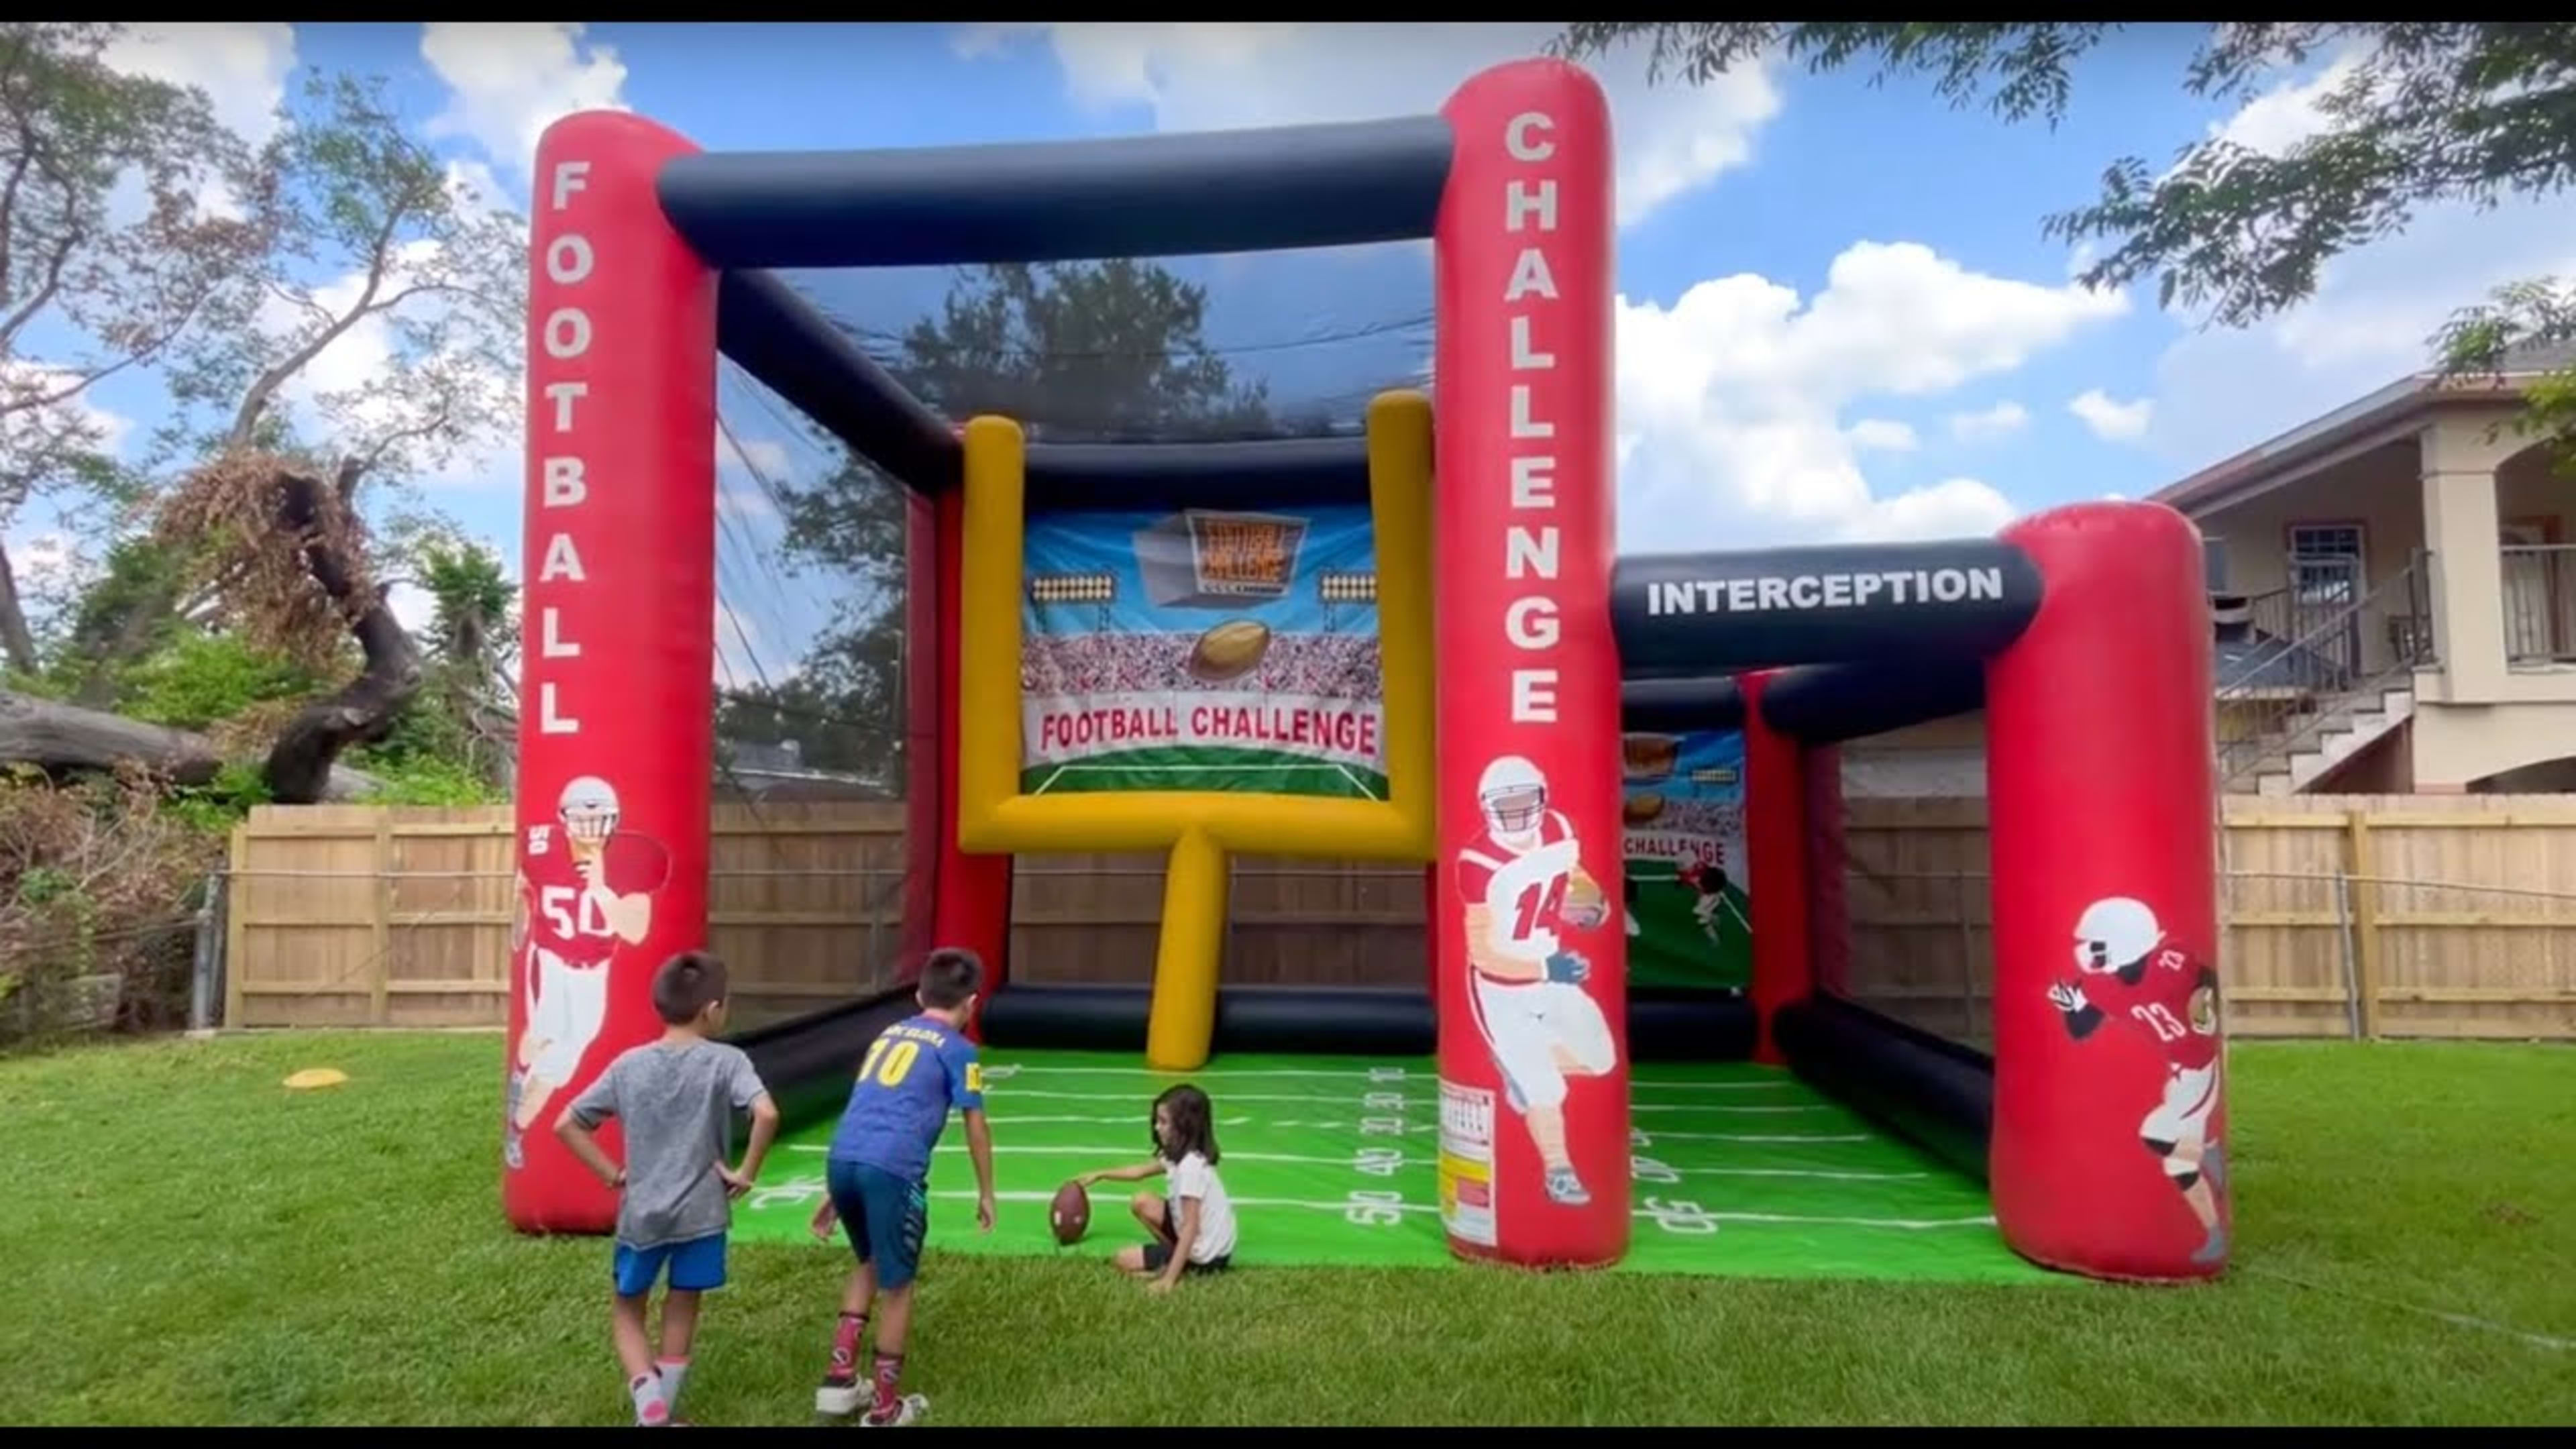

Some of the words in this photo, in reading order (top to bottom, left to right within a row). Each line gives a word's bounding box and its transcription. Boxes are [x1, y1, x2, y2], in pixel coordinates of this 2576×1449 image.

[1503, 111, 1560, 723] CHALLENGE
[539, 160, 594, 735] FOOTBALL
[1648, 568, 2003, 616] INTERCEPTION
[1041, 708, 1179, 751] FOOTBALL
[1191, 706, 1376, 755] CHALLENGE
[541, 884, 616, 940] 50
[1511, 871, 1568, 941] 14
[2130, 1002, 2186, 1041] 23
[857, 1037, 919, 1087] 10
